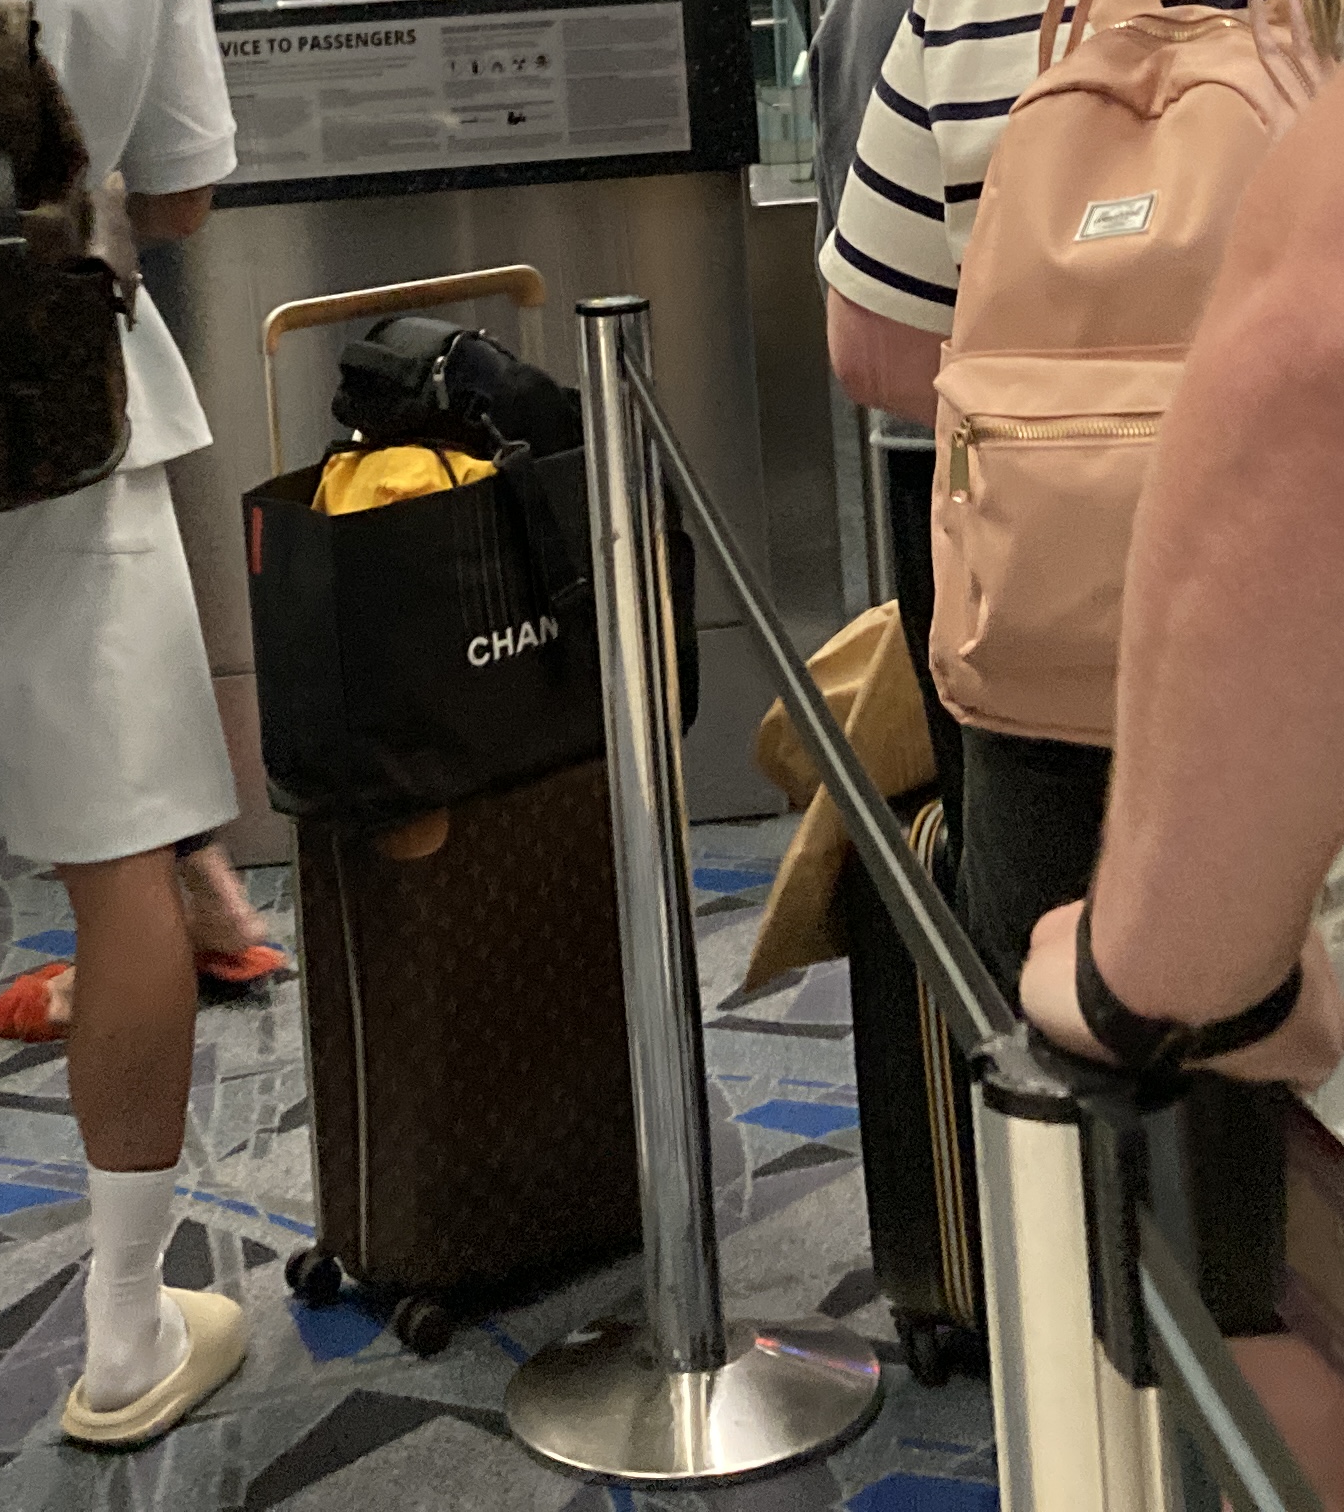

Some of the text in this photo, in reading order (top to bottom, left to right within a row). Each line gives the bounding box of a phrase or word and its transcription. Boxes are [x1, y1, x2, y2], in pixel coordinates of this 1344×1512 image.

[219, 28, 417, 57] VICE TO PASSENGERS
[467, 615, 559, 666] CHAN
